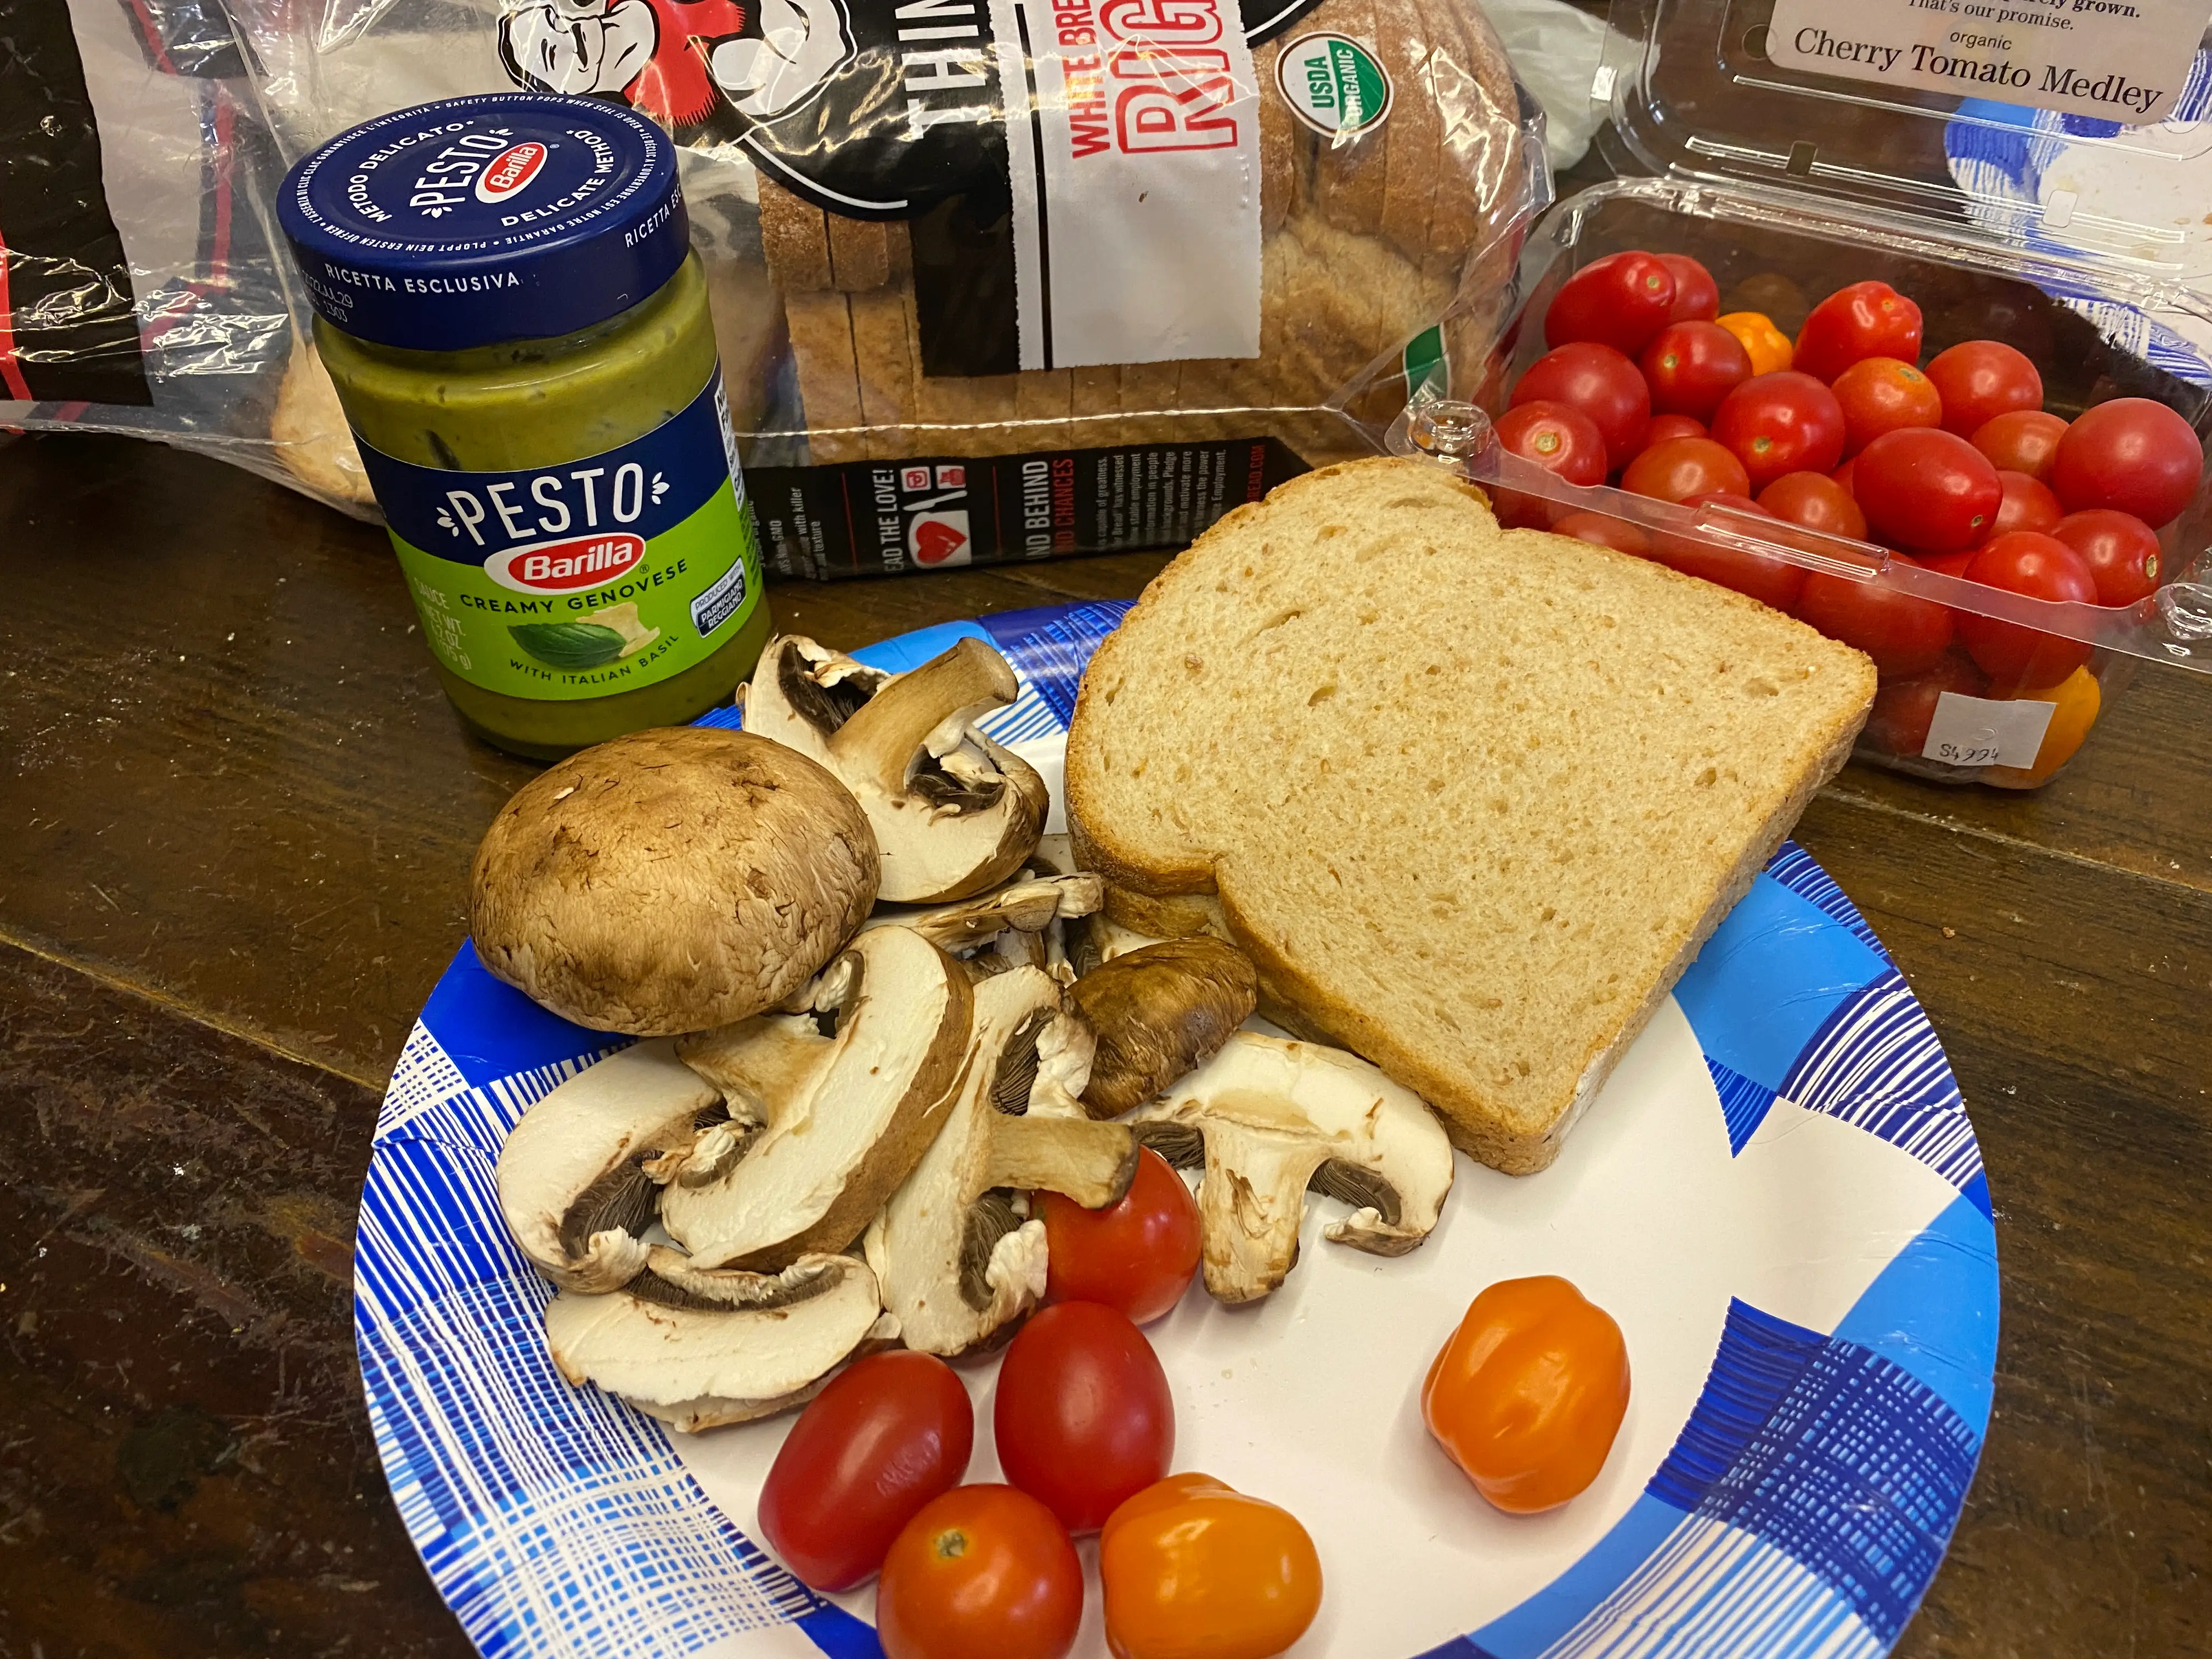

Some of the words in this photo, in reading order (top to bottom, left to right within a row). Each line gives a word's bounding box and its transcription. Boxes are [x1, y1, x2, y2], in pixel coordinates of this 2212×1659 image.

[1964, 3, 1995, 18] our
[1997, 9, 2074, 30] promise.
[1949, 31, 2012, 50] organic
[1304, 56, 1335, 108] USDA
[1336, 48, 1364, 117] ORGANIC
[1794, 26, 1902, 72] Cherry
[1911, 43, 2032, 89] Tomato
[2038, 65, 2164, 114] Medley
[445, 98, 487, 108] SAFETY
[566, 99, 594, 108] WHEN
[593, 104, 616, 115] SEAL
[623, 116, 643, 129] OPEN
[1062, 55, 1111, 159] WHITE
[317, 129, 367, 160] GARANTISCE
[409, 134, 509, 207] PESTO
[489, 146, 538, 189] Barilla
[348, 174, 393, 223] METODO
[500, 178, 606, 227] DELICATE
[601, 199, 620, 211] EST
[323, 224, 360, 244] ÖFFNEN
[506, 224, 565, 245] GARANTIE
[567, 210, 602, 227] NOTRE
[625, 204, 670, 248] RICETTA
[359, 237, 402, 251] ERSTEN
[405, 244, 435, 252] BEIN
[438, 241, 487, 251] PLOPPT
[325, 263, 396, 292] RICETTA
[404, 272, 520, 294] ESCLUSIVA
[1096, 456, 1110, 498] greatness.
[1113, 454, 1125, 493] witnessed
[1128, 453, 1144, 501] employment
[1147, 452, 1160, 480] people
[1161, 452, 1178, 478] Pledge
[1182, 451, 1194, 472] more
[1198, 450, 1211, 475] power
[1211, 449, 1227, 501] Employment.
[872, 468, 898, 512] LOVE!
[1021, 460, 1052, 530] BEHIND
[1051, 457, 1077, 528] CHANCES
[1145, 481, 1158, 489] in
[1179, 474, 1193, 510] motivate
[1196, 476, 1208, 490] the
[446, 462, 644, 546] PESTO
[790, 487, 805, 513] killer
[1095, 499, 1108, 507] of
[1112, 494, 1125, 508] has
[1128, 501, 1141, 526] stable
[793, 513, 808, 535] with
[810, 521, 824, 552] texture
[878, 512, 902, 544] THE
[524, 541, 633, 580] Barilla
[460, 593, 554, 614] CREAMY
[567, 558, 689, 611] GENOVESE
[695, 579, 728, 611] PRODUCED
[701, 578, 743, 624] PARMIGIANO
[708, 591, 742, 629] REGGIANO
[510, 659, 551, 682] WITH
[562, 665, 631, 686] ITALIAN
[639, 633, 680, 668] BASIL
